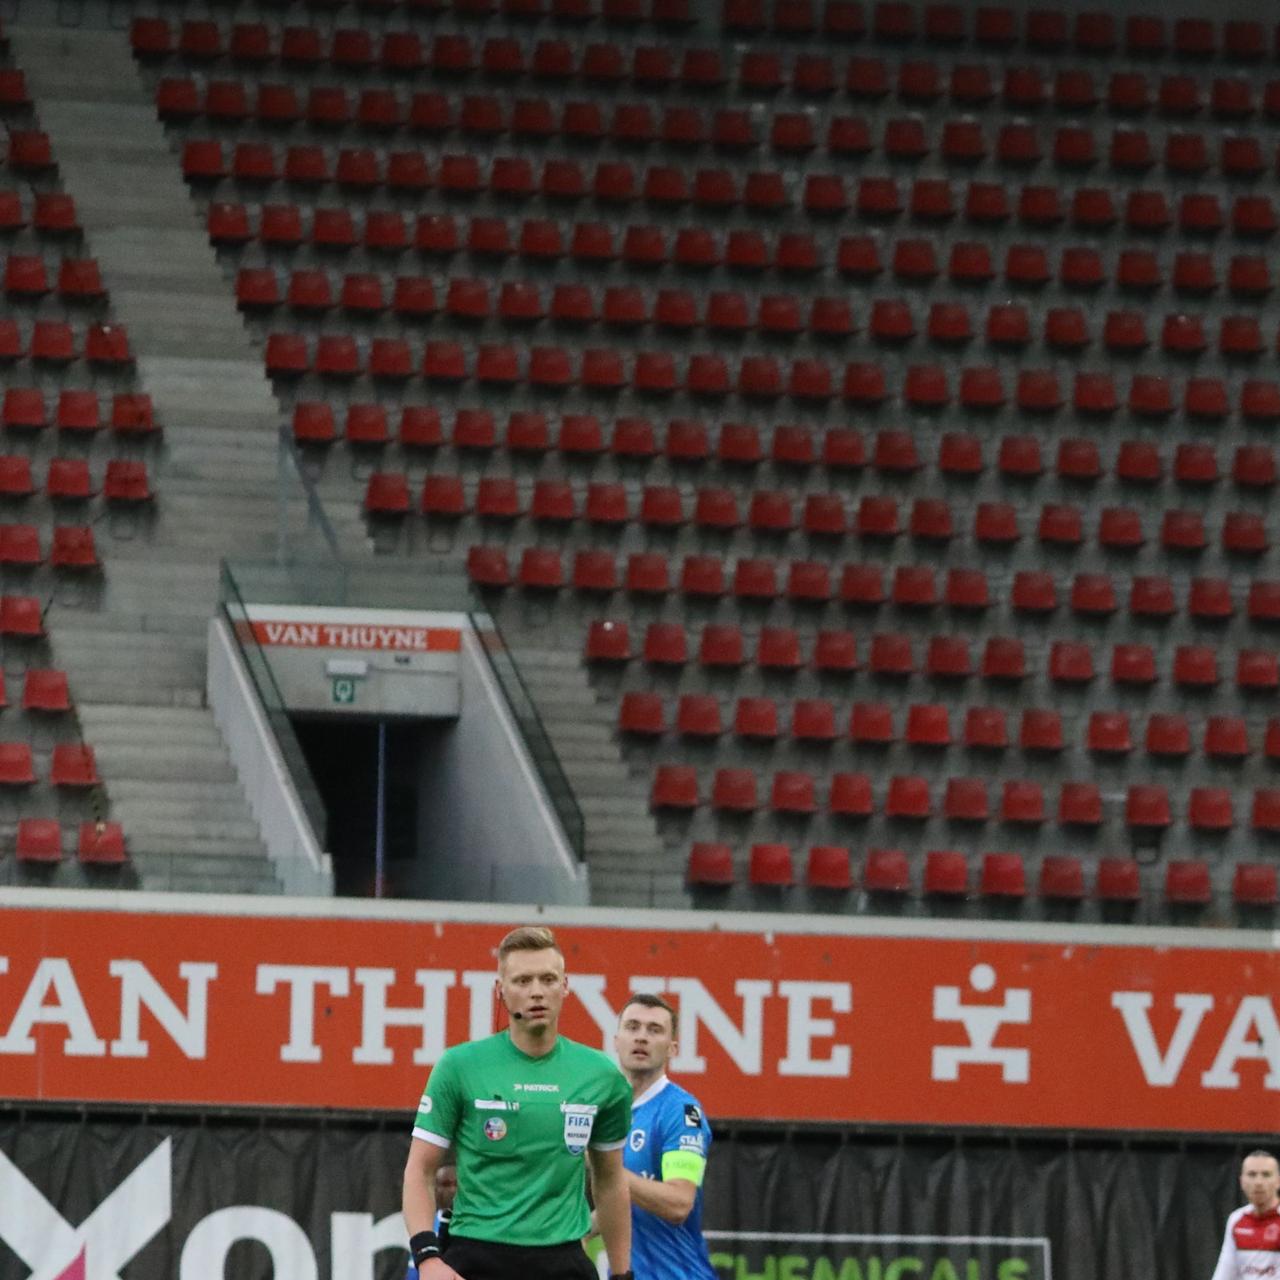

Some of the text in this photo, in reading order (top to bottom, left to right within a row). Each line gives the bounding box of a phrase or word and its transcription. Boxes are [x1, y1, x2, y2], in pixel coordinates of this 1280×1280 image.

[264, 624, 428, 650] VAN THUYNE
[0, 957, 218, 1060] AN
[523, 1083, 560, 1092] PATRICK
[567, 1115, 590, 1128] FIFA
